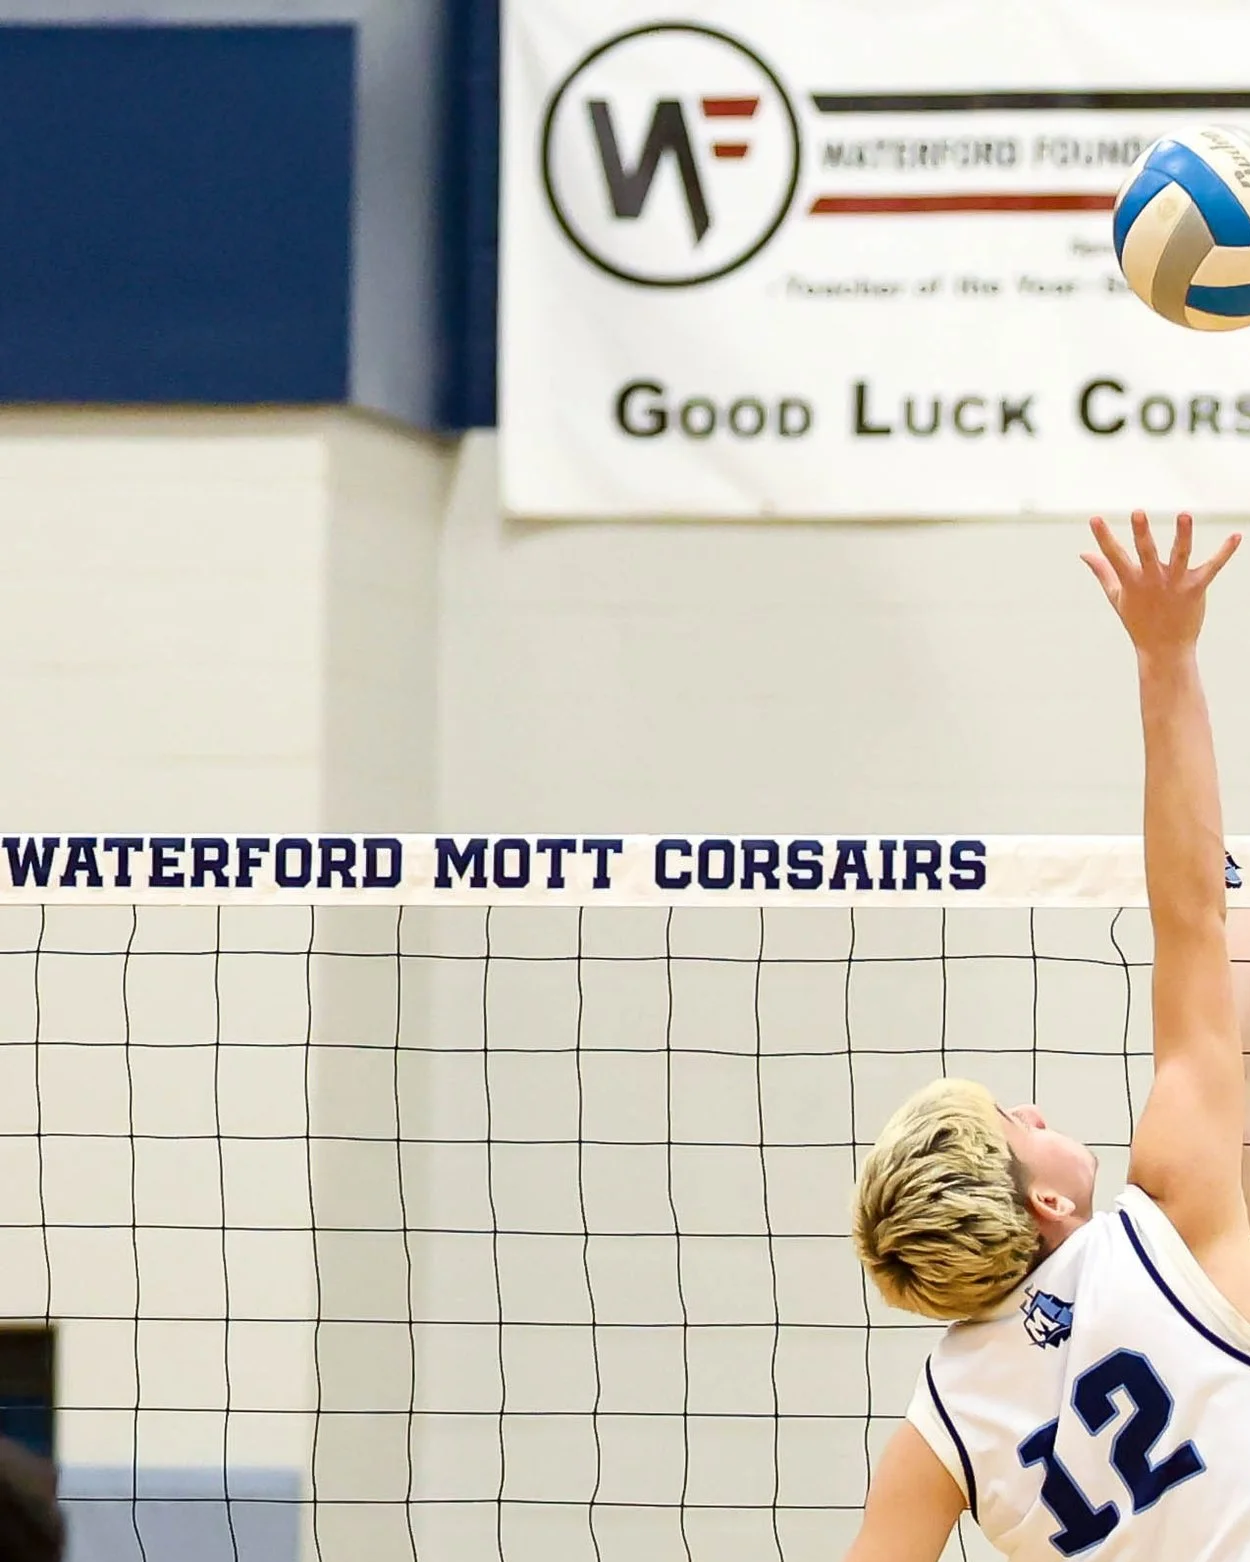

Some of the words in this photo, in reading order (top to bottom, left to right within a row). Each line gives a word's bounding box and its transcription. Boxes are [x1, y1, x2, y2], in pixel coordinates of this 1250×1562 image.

[1034, 136, 1152, 167] FOUND
[2, 838, 403, 887] WATERFORD
[435, 839, 623, 889] MOTT
[655, 840, 987, 891] CORSAIRS
[1016, 1347, 1207, 1557] 12
